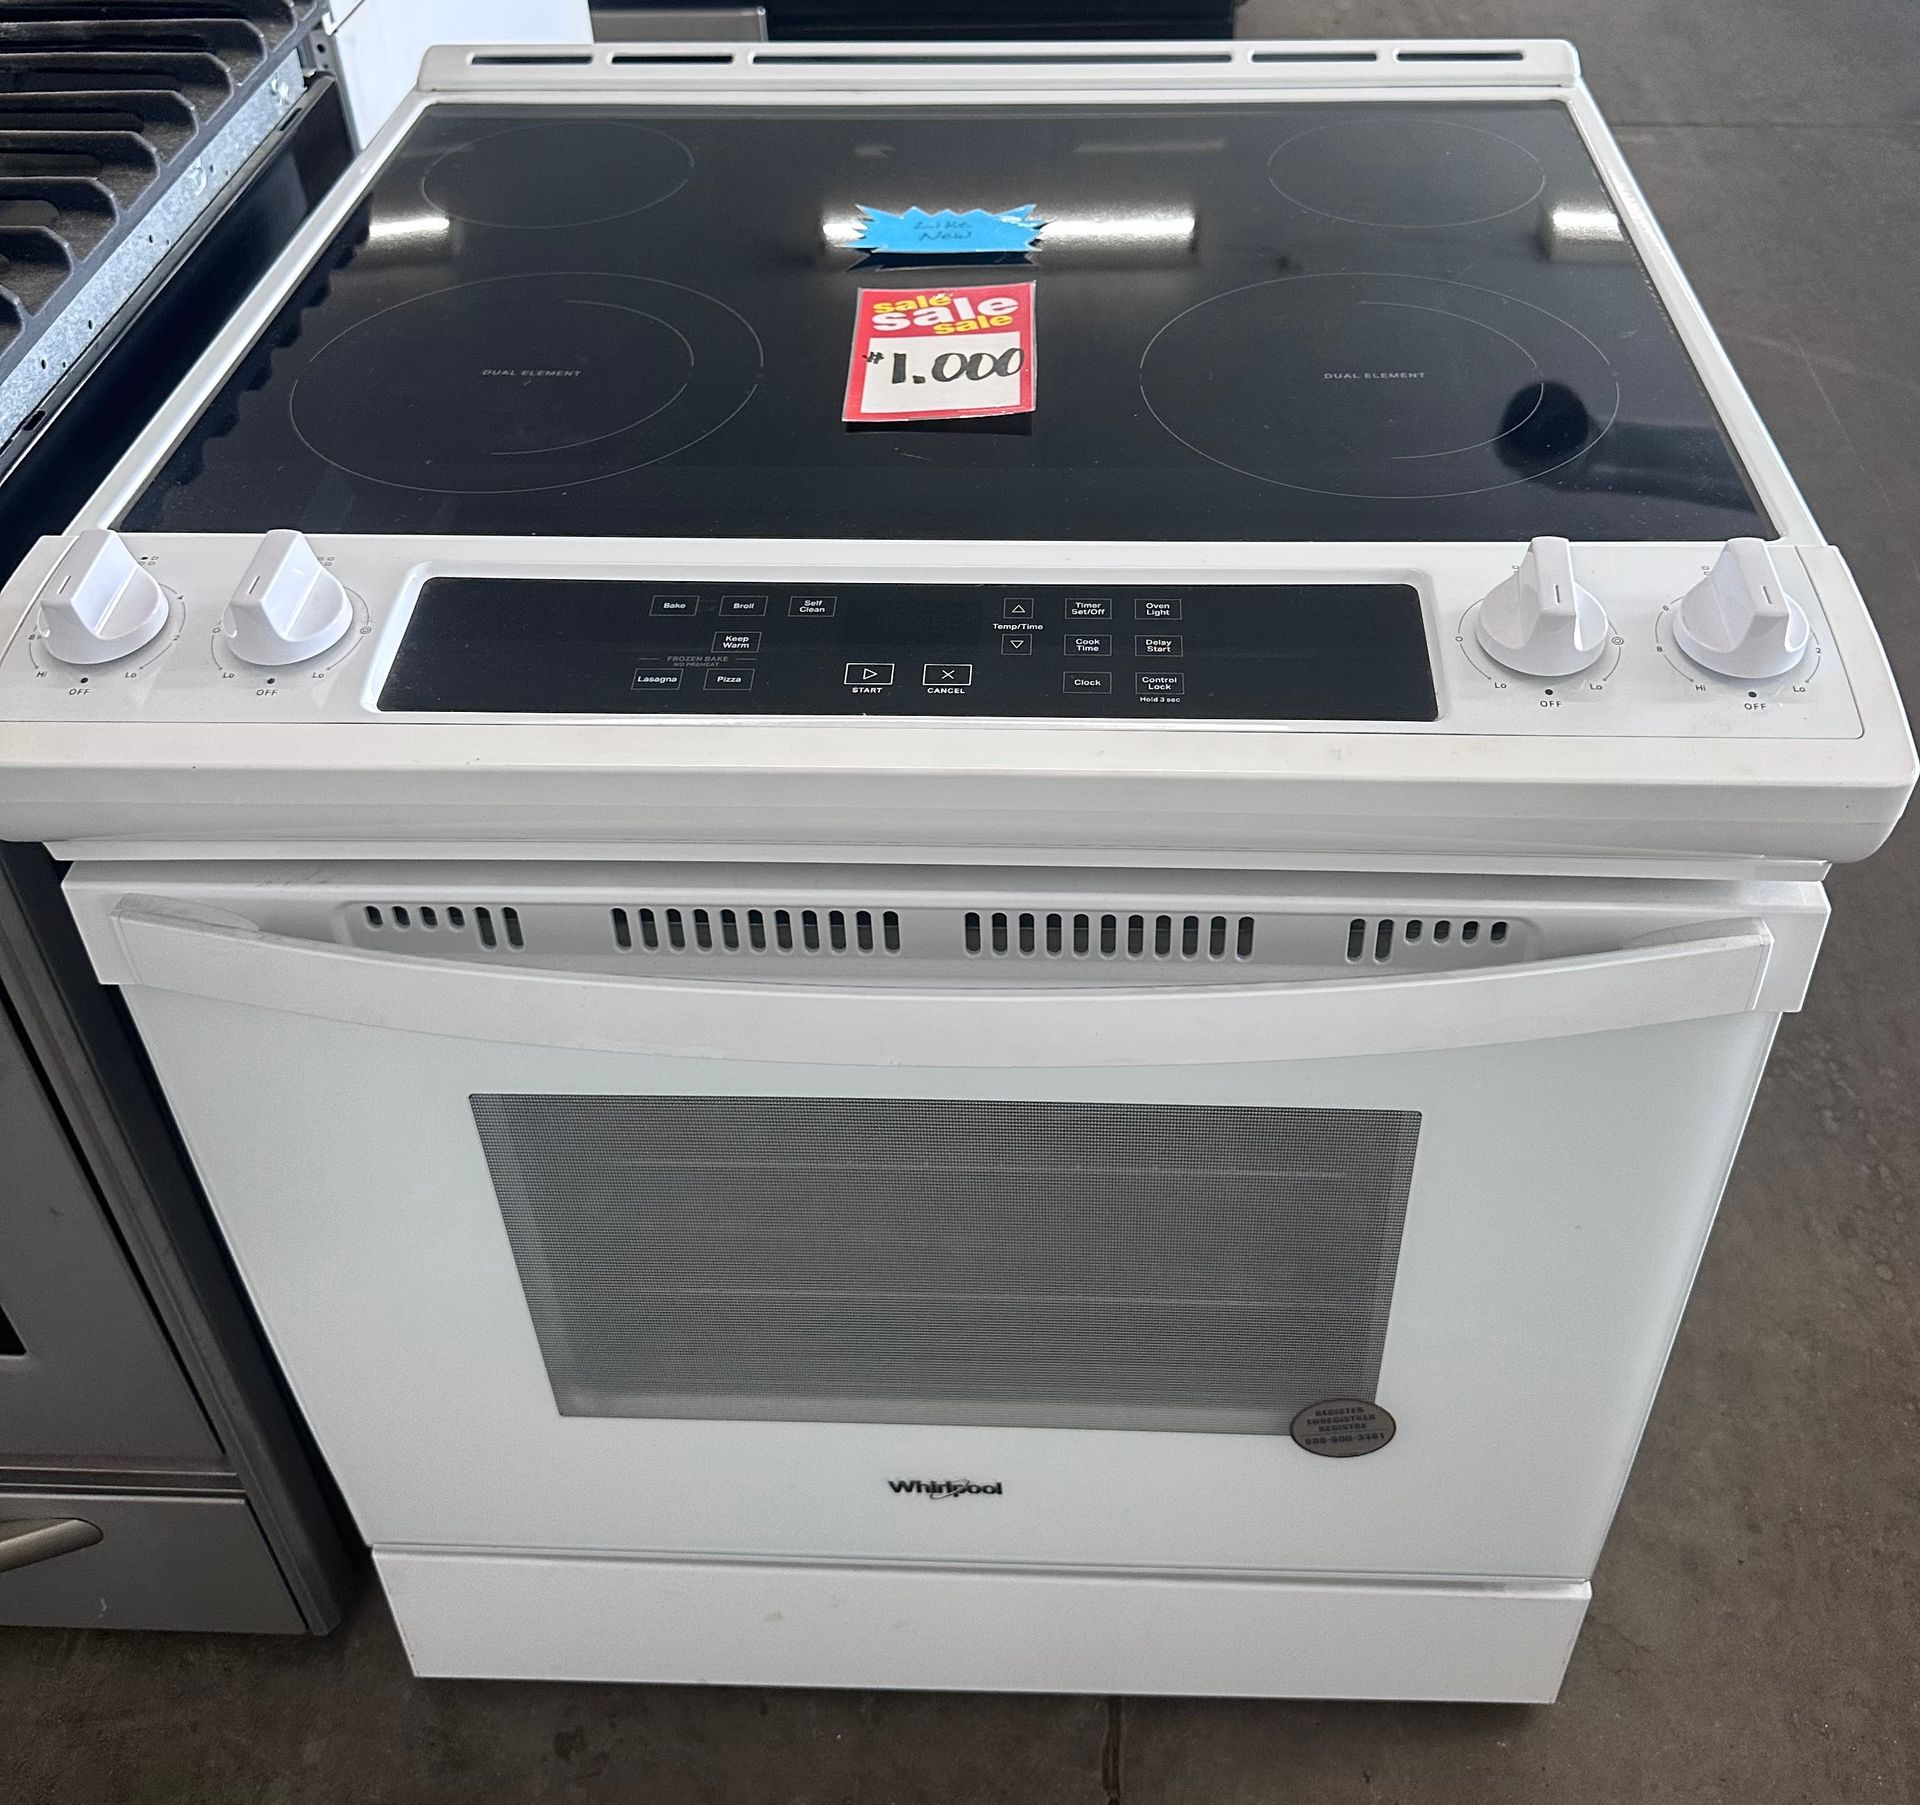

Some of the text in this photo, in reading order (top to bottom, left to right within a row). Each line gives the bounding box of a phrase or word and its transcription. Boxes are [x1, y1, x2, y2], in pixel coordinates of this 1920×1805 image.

[872, 293, 952, 313] sale
[872, 297, 1019, 331] sale
[933, 315, 1013, 335] sale
[482, 369, 517, 377] DUAL
[1364, 372, 1425, 380] ELEMENT
[663, 602, 686, 610] Bake
[733, 602, 755, 610] Broil
[1071, 608, 1106, 616] Set/Off
[1146, 609, 1170, 617] Light
[993, 623, 1044, 631] Temp/Time
[725, 635, 750, 643] Keep
[1075, 638, 1101, 646] Cook
[1145, 639, 1172, 647] Delay
[36, 671, 48, 679] Hi
[124, 671, 137, 679] Lo
[637, 675, 678, 683] Lasagna
[716, 675, 742, 683] Pizza
[1074, 678, 1101, 686] Clock
[1142, 676, 1178, 684] Control
[1148, 683, 1172, 691] Lock
[1695, 684, 1706, 692] Hi
[1792, 685, 1806, 693] Lo
[68, 688, 91, 696] OFF
[256, 688, 278, 696] OFF
[1540, 700, 1563, 708] OFF
[1744, 702, 1767, 710] OFF
[888, 1480, 1003, 1498] Whirlpool
